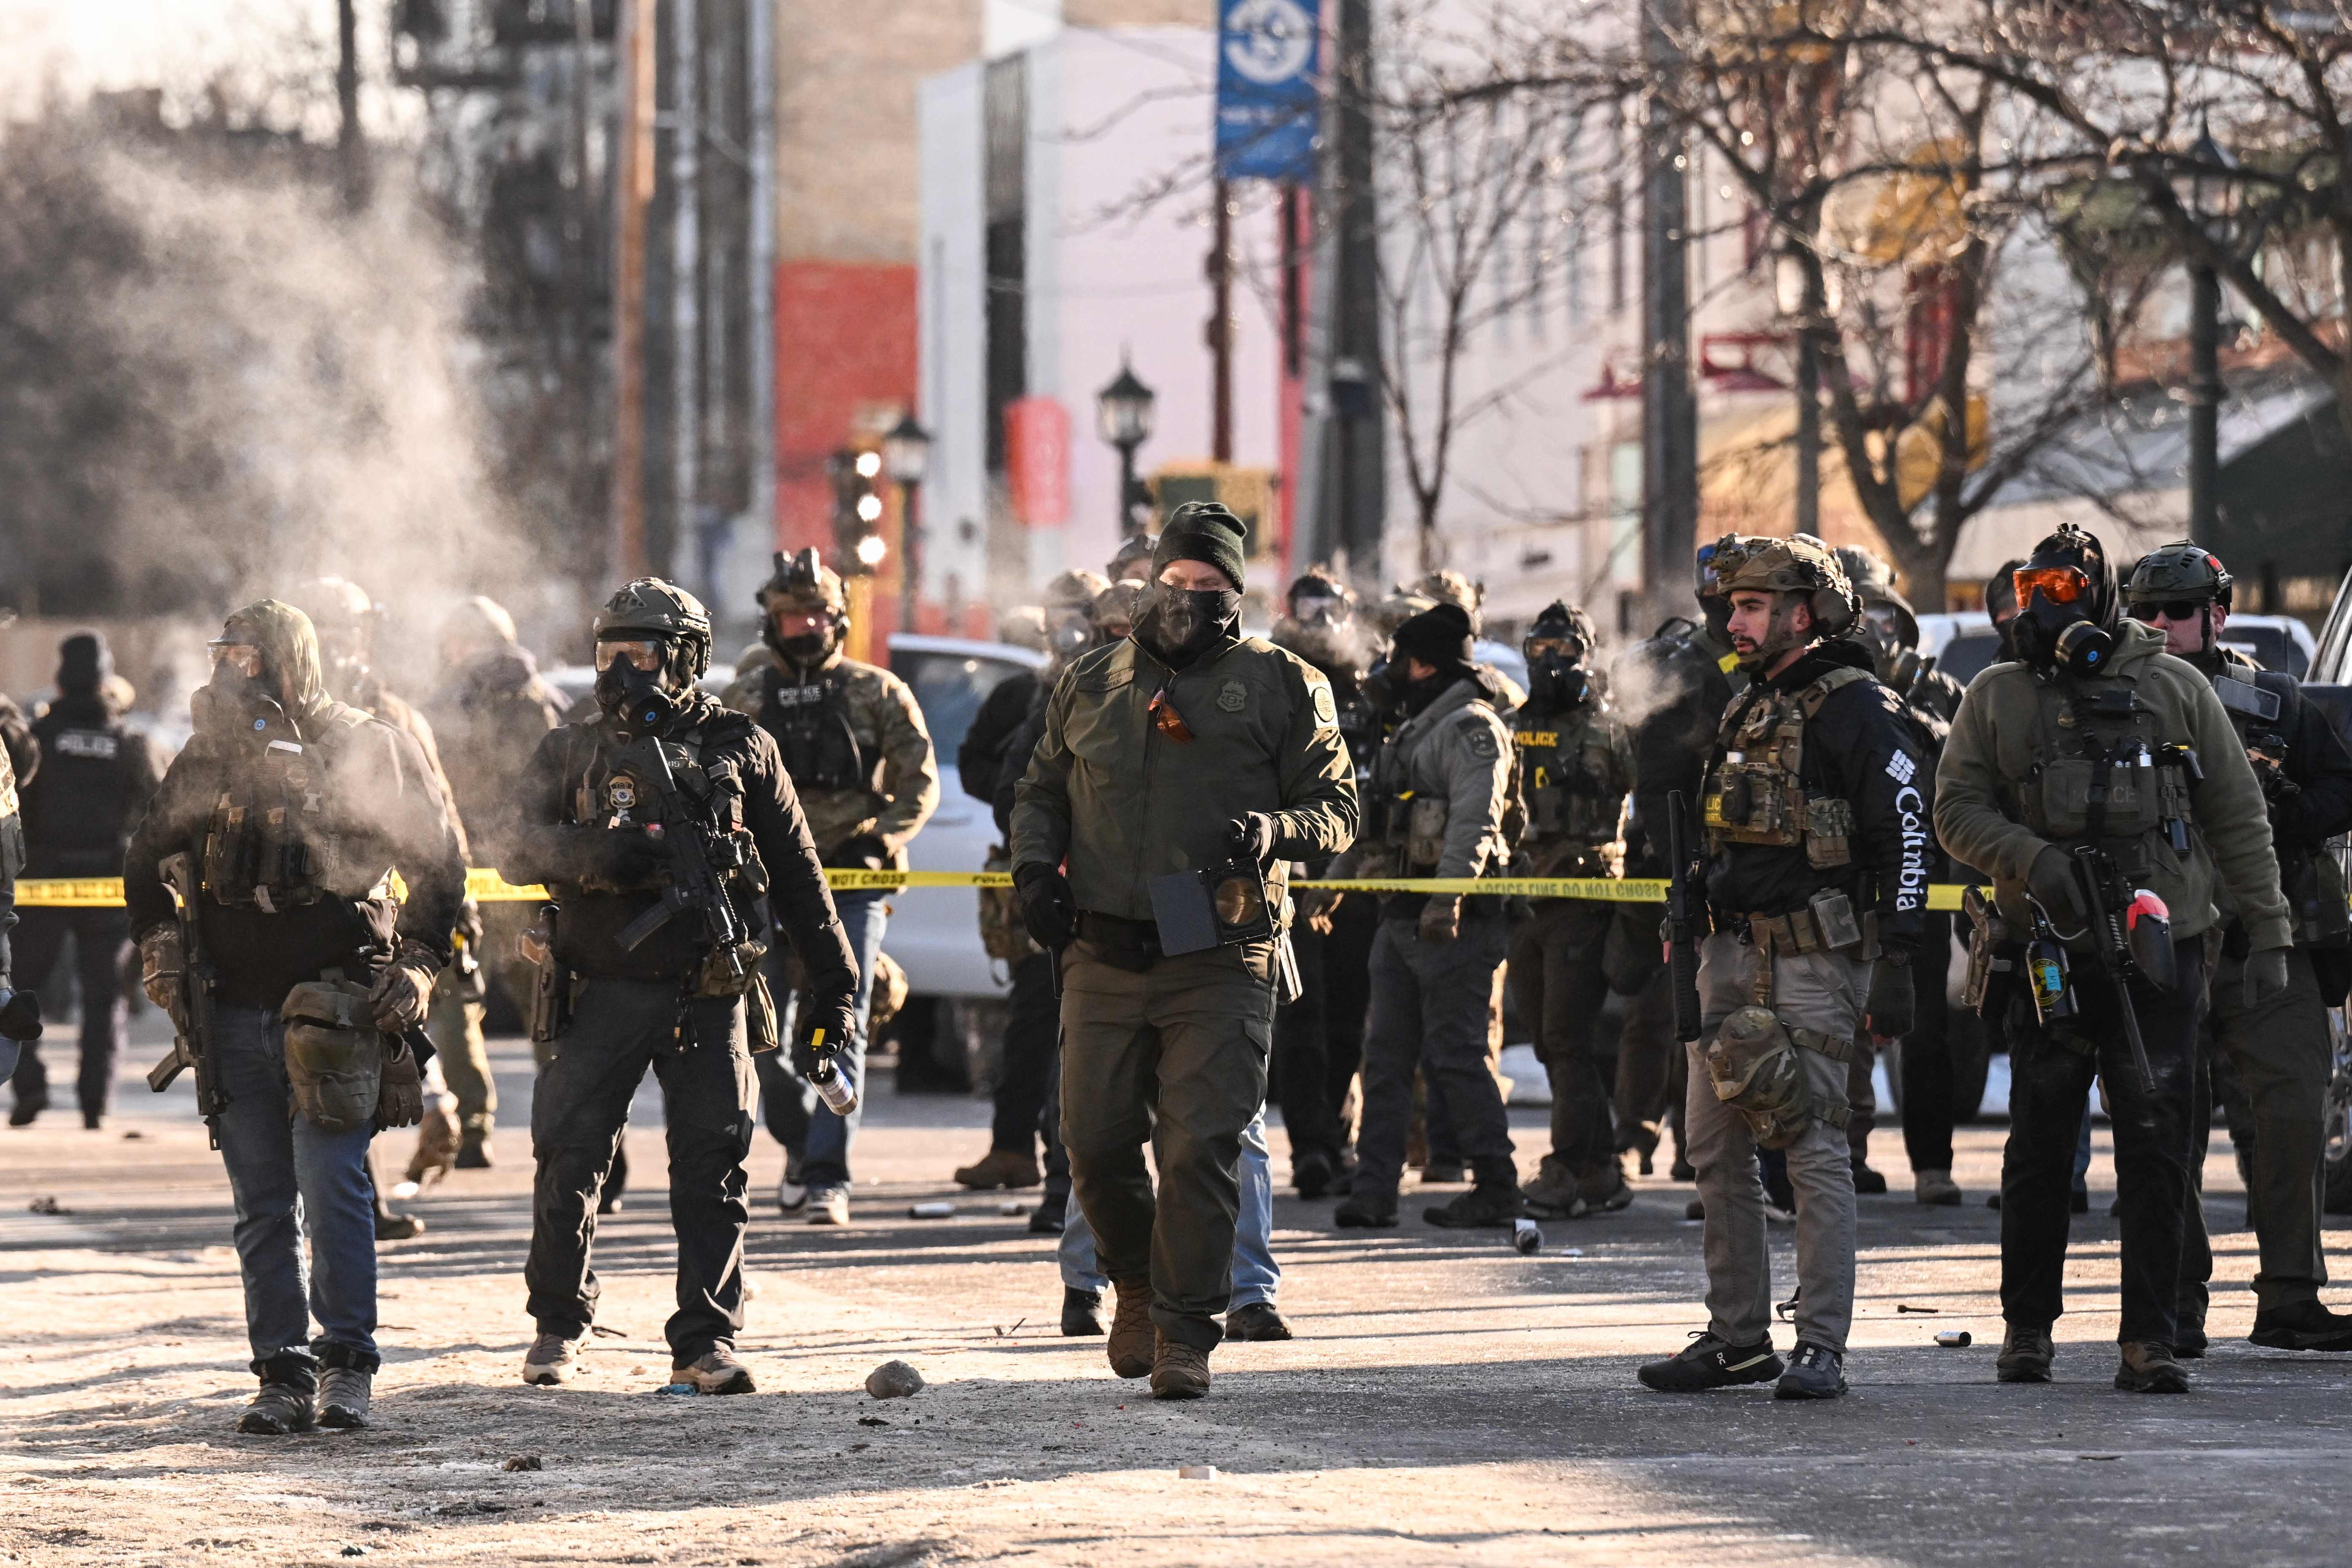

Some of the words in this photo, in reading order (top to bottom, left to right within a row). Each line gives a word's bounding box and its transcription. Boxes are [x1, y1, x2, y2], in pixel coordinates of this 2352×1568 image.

[831, 874, 857, 885] NOT
[861, 873, 907, 885] CROSS
[1896, 787, 1924, 911] Columbia
